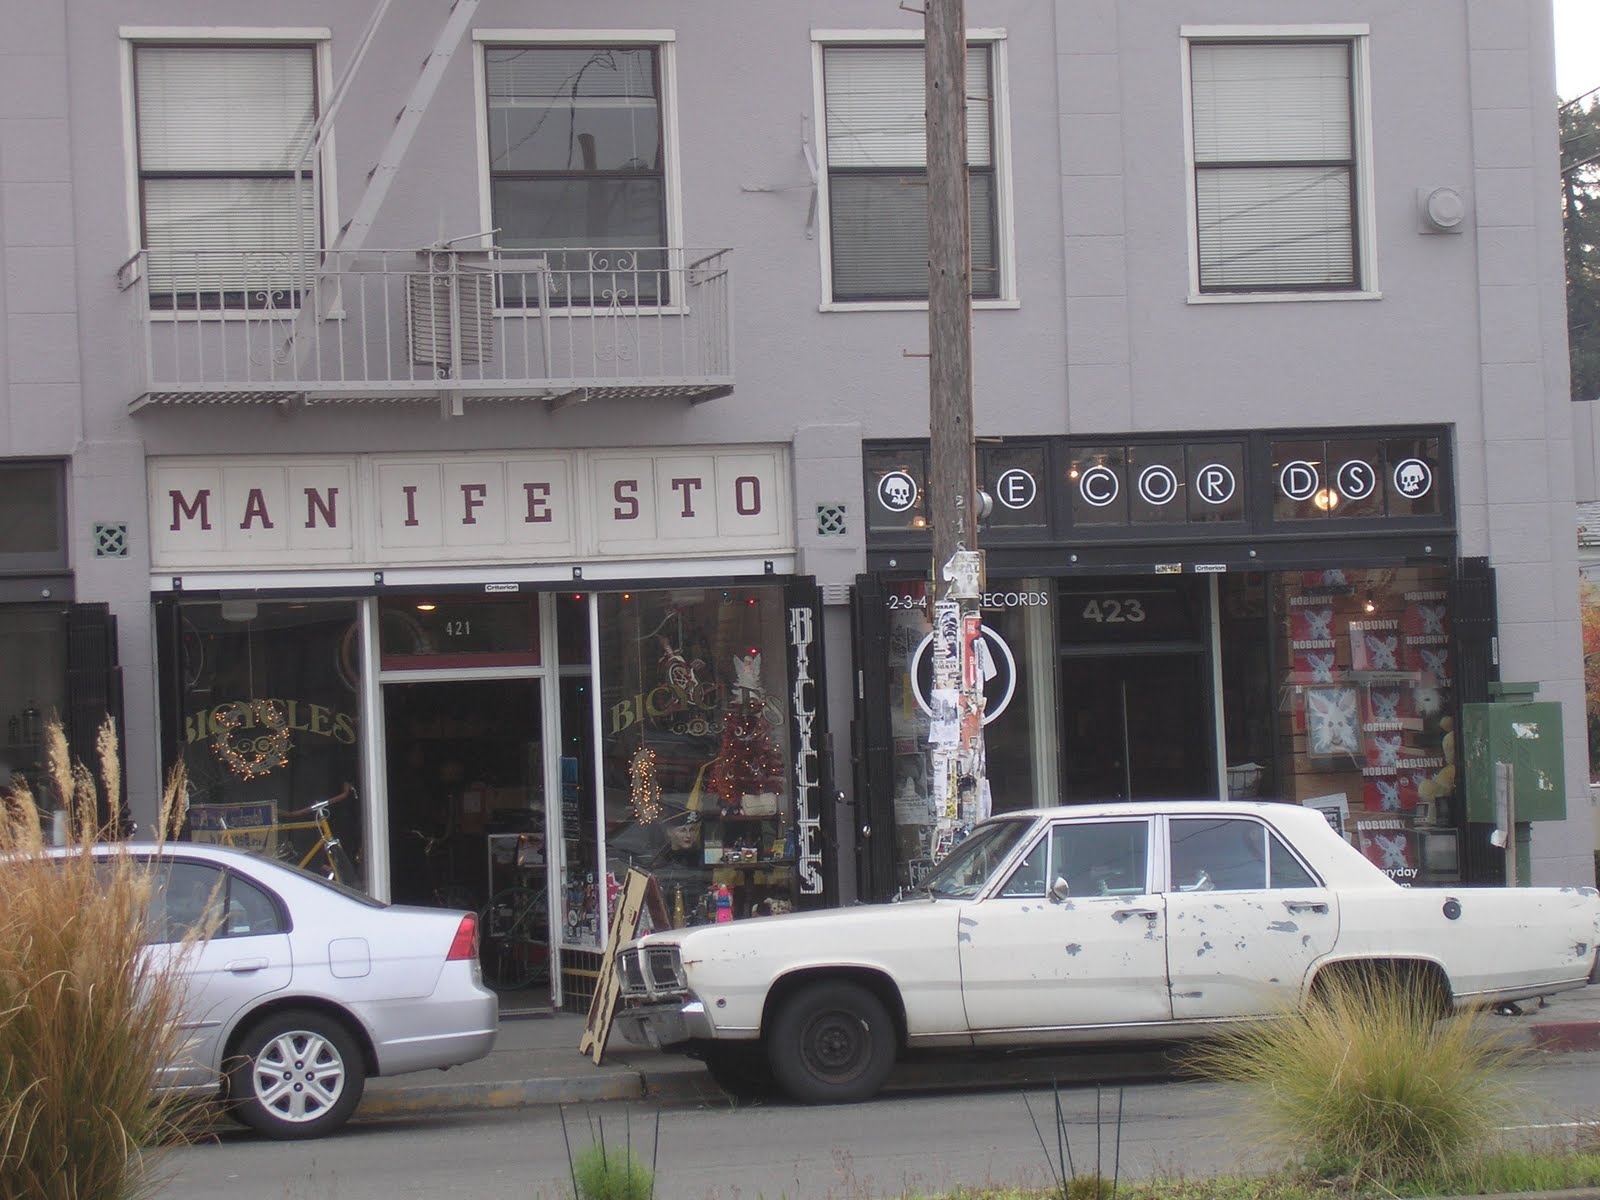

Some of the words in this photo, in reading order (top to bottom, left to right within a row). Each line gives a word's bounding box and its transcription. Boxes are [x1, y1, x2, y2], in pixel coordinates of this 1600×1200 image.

[1002, 458, 1362, 508] ECORDS
[169, 476, 761, 531] MANIFESTO
[1290, 596, 1333, 606] NOBUNNY
[1404, 591, 1446, 601] NOBUNNY
[1082, 599, 1146, 622] 423
[446, 621, 471, 635] 421
[1349, 619, 1398, 631] NOBUNNY
[1292, 639, 1336, 650] NOBUNNY
[1406, 635, 1449, 645] NOBUNNY
[790, 608, 824, 894] BICYCLES
[1395, 757, 1444, 769] NOBUNNY
[1357, 819, 1406, 831] NOBUNNY
